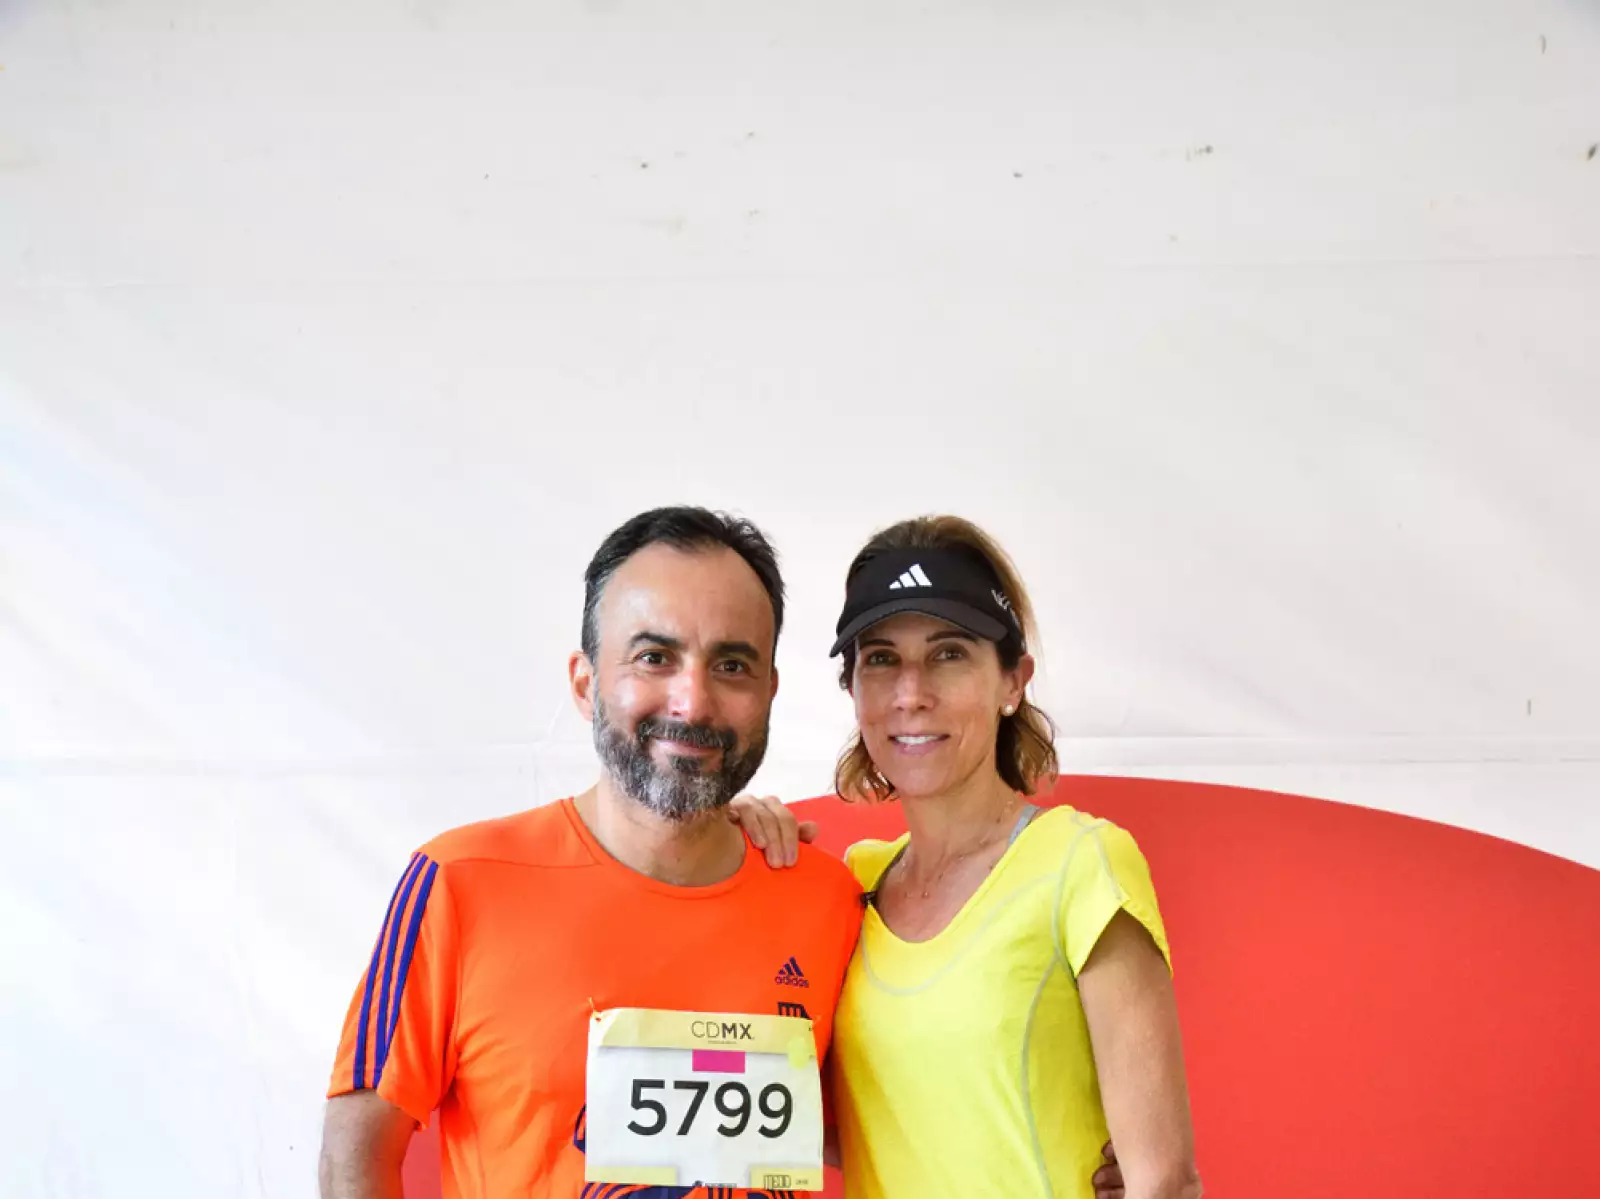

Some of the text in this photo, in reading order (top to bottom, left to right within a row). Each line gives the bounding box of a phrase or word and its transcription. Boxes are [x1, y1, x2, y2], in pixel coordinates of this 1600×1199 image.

[774, 975, 809, 988] adidas
[691, 1020, 752, 1040] CDMX
[627, 1078, 794, 1138] 5799
